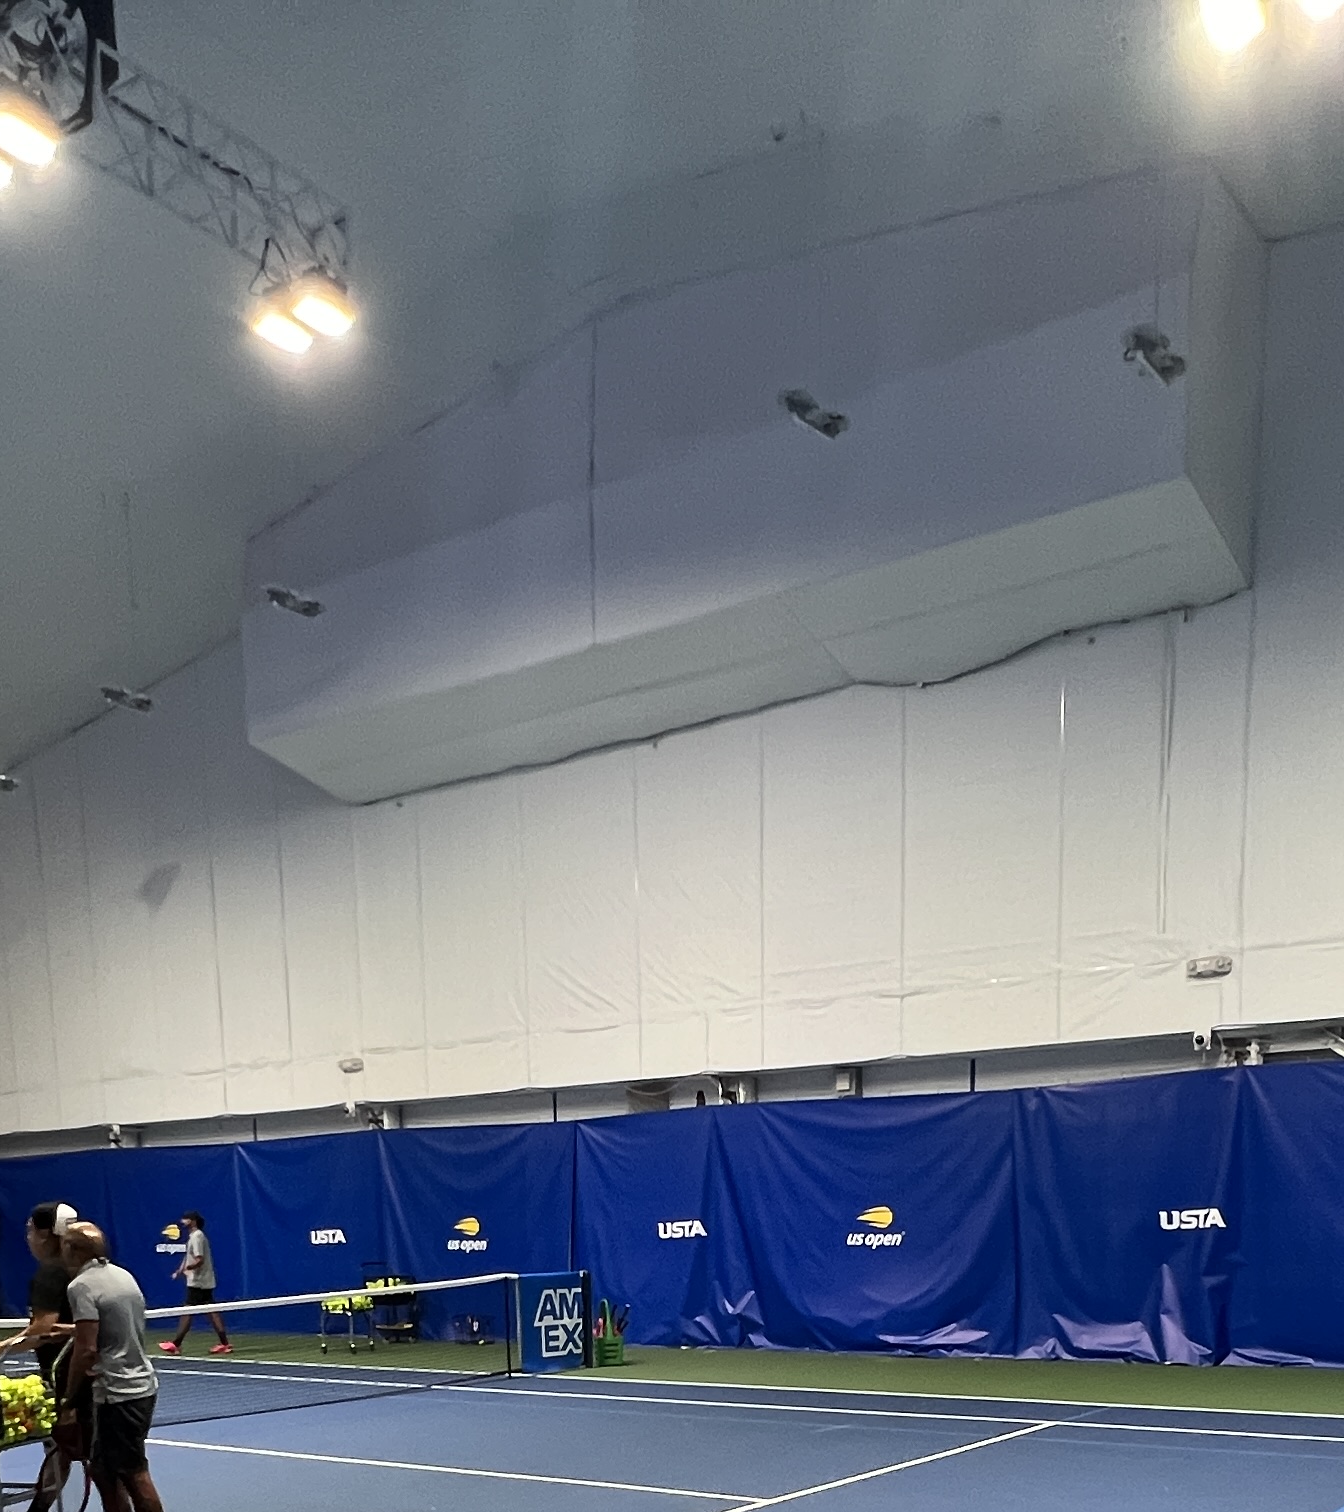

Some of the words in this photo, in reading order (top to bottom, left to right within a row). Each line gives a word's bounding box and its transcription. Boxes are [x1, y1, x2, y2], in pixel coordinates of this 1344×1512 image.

[1158, 1208, 1227, 1230] USTA
[310, 1229, 347, 1245] USTA
[657, 1220, 708, 1239] USTA
[846, 1233, 865, 1246] us
[864, 1233, 903, 1250] open
[535, 1288, 582, 1325] AM
[543, 1322, 583, 1356] EX
